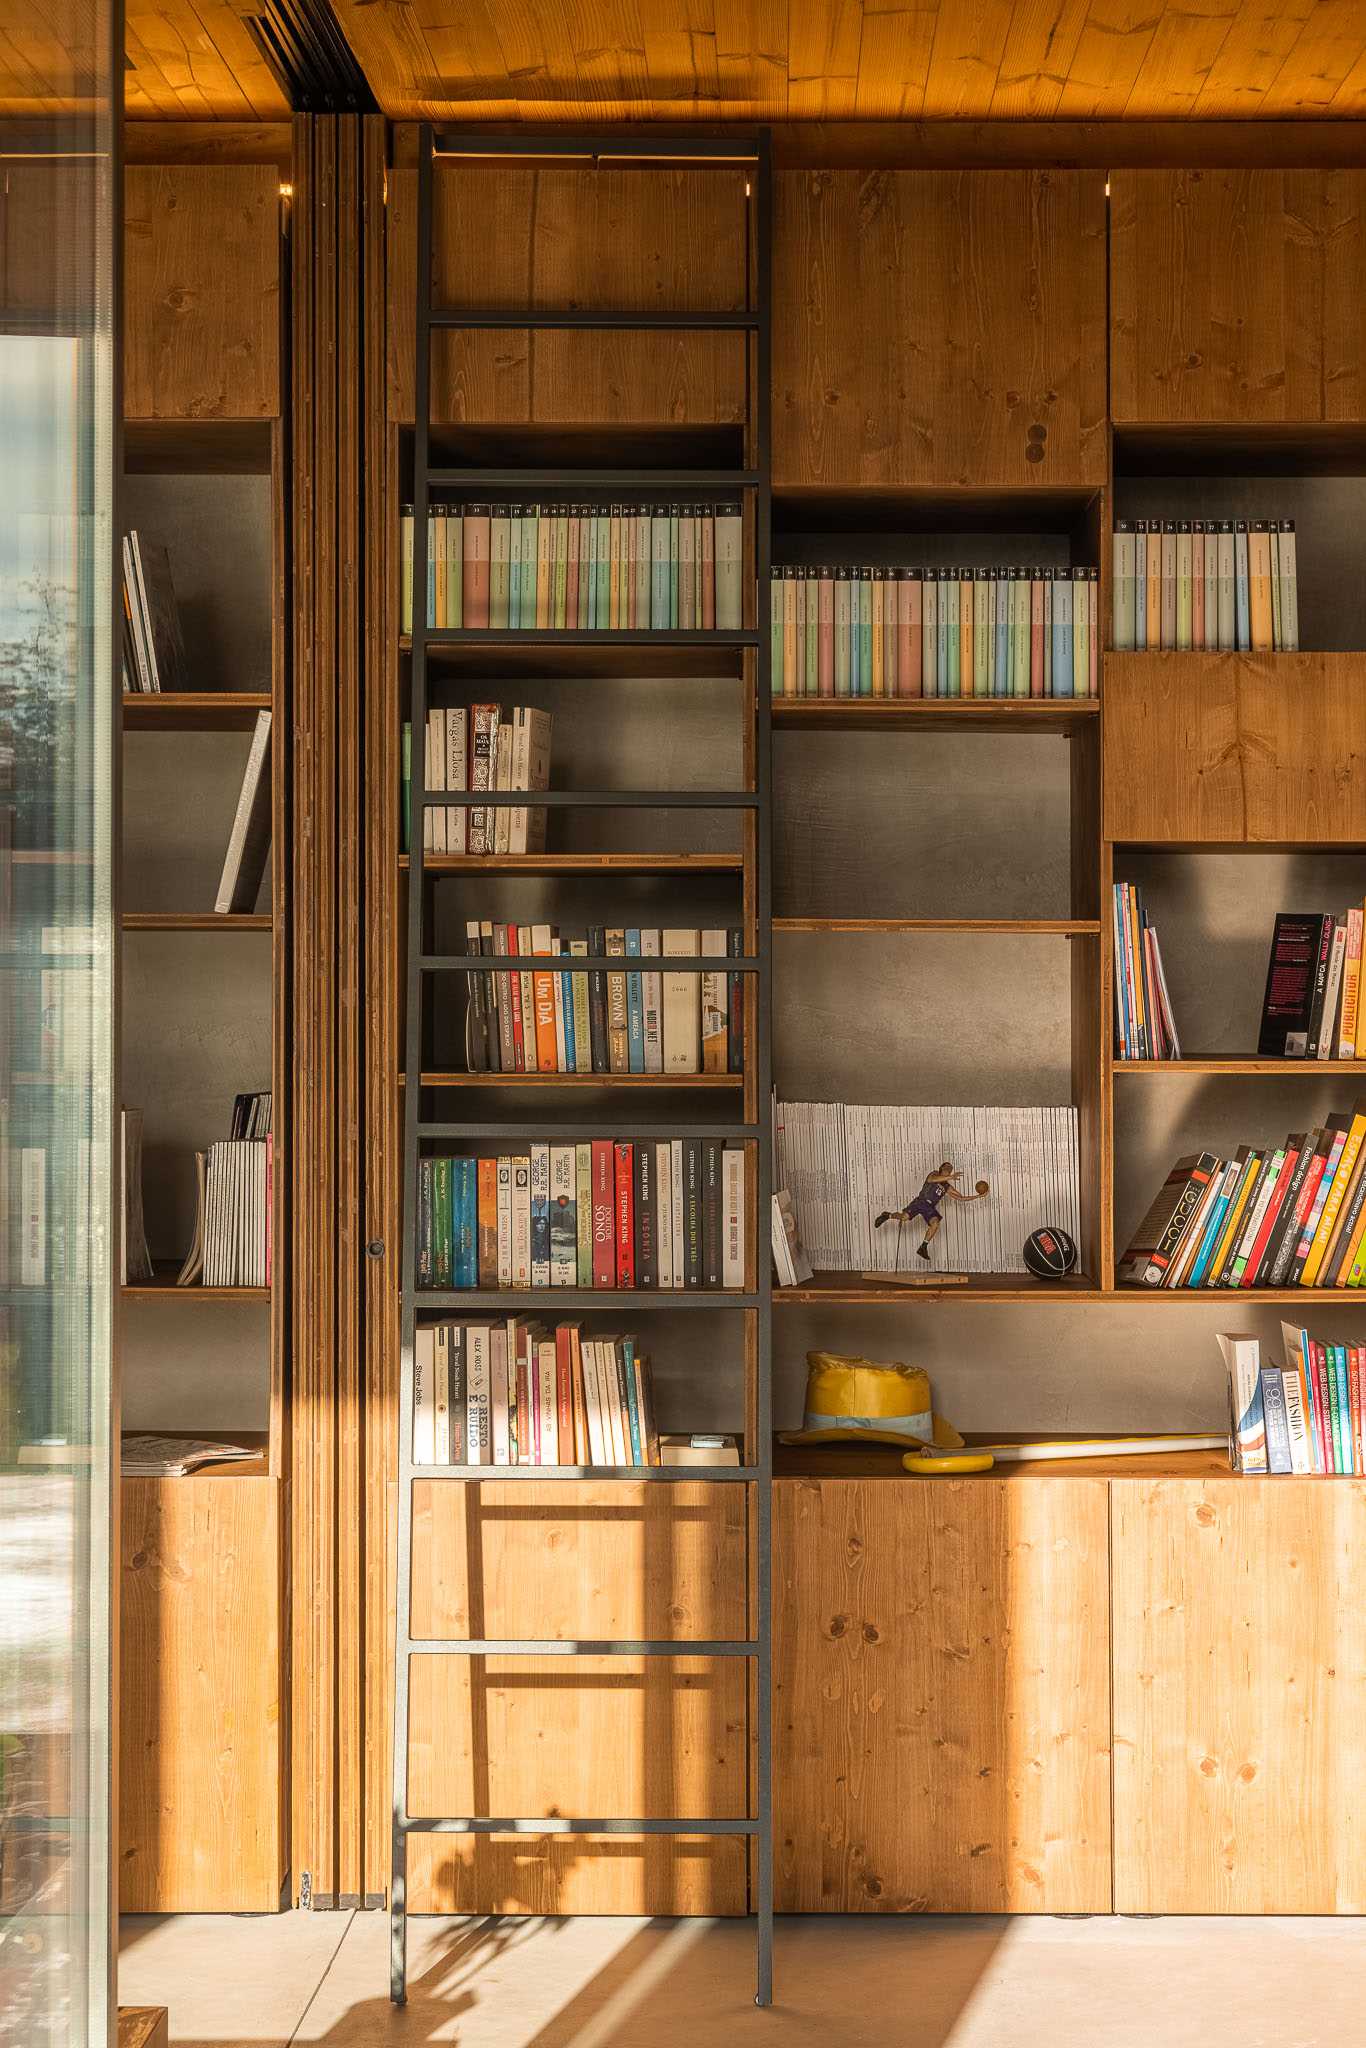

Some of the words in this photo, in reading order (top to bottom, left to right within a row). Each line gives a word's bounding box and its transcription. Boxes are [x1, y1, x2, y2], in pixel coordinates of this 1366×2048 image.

[449, 712, 462, 747] Vargas
[452, 750, 463, 780] Llosa
[1321, 939, 1330, 961] WALLY
[612, 976, 623, 1021] BROWN
[1343, 975, 1357, 1035] PUBLICITOR
[641, 1153, 649, 1183] STEPHEN
[1298, 1146, 1312, 1171] Fashion
[1291, 1172, 1302, 1193] design
[1327, 1181, 1344, 1213] PARA
[595, 1205, 606, 1242] SONO
[622, 1226, 630, 1244] KING
[415, 1387, 423, 1406] Jobs
[545, 1384, 551, 1394] DA
[1285, 1372, 1298, 1396] THE
[478, 1394, 487, 1403] O
[479, 1407, 488, 1447] RESTO
[1287, 1396, 1304, 1441] FASHION
[1322, 1410, 1330, 1436] STUDIOS
